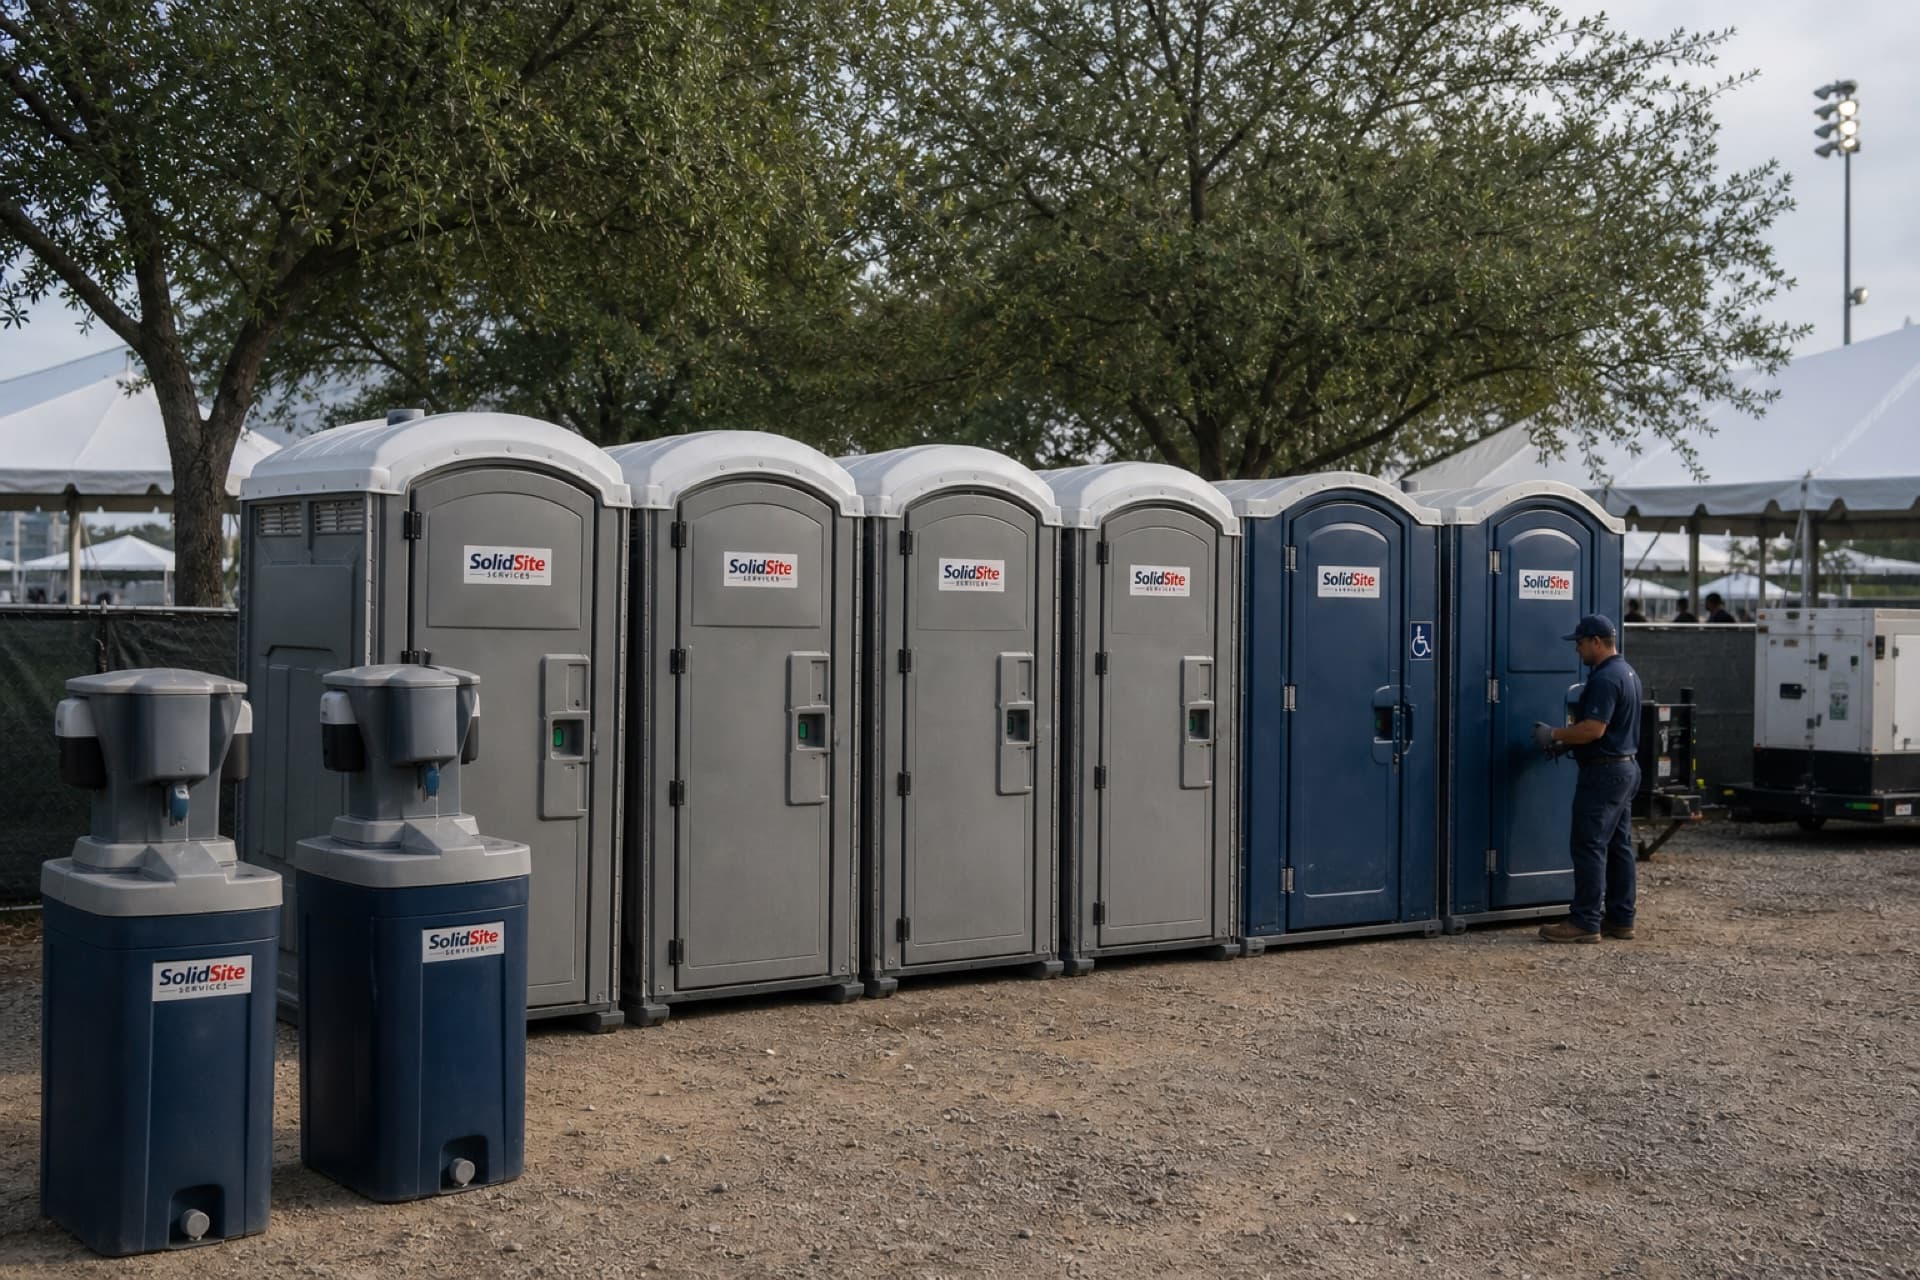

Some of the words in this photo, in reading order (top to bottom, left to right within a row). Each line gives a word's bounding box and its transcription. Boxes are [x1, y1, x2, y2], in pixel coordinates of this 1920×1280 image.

[470, 553, 545, 571] SolidSite
[729, 559, 792, 575] SolidSite
[944, 565, 999, 580] SolidSite
[1135, 571, 1185, 585] SolidSite
[1323, 572, 1375, 586] SolidSite
[1524, 575, 1569, 589] SolidSite
[429, 930, 498, 949] SolidSite
[160, 964, 245, 985] SolidSite
